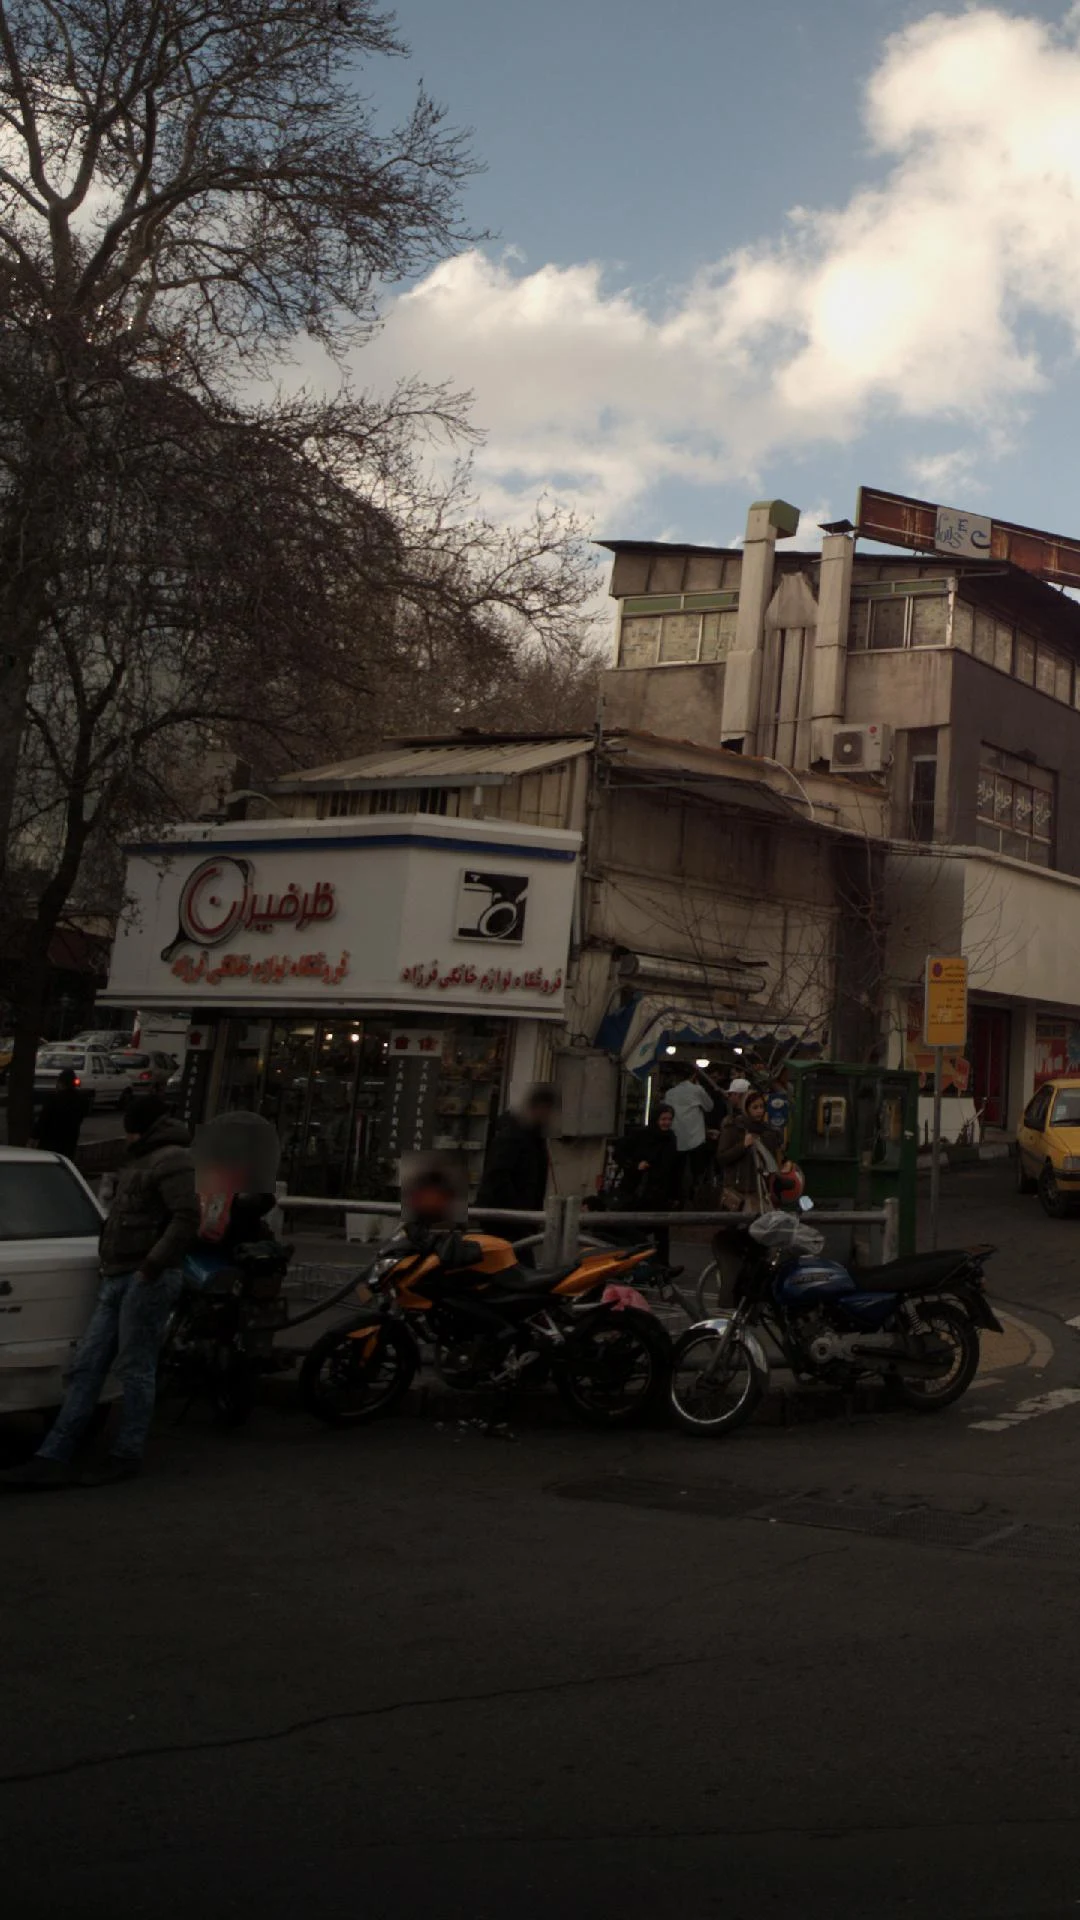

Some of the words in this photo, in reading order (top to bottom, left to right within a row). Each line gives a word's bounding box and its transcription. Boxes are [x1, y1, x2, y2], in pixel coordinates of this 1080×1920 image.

[206, 953, 251, 985] خانگی
[251, 954, 290, 984] لوازم
[290, 950, 351, 985] فروشگاه
[402, 959, 438, 988] فرزاد
[438, 963, 478, 989] خانگی
[479, 967, 512, 993] لوازم
[515, 967, 562, 993] فروشگاه
[413, 1060, 429, 1151] ZARFIRAN
